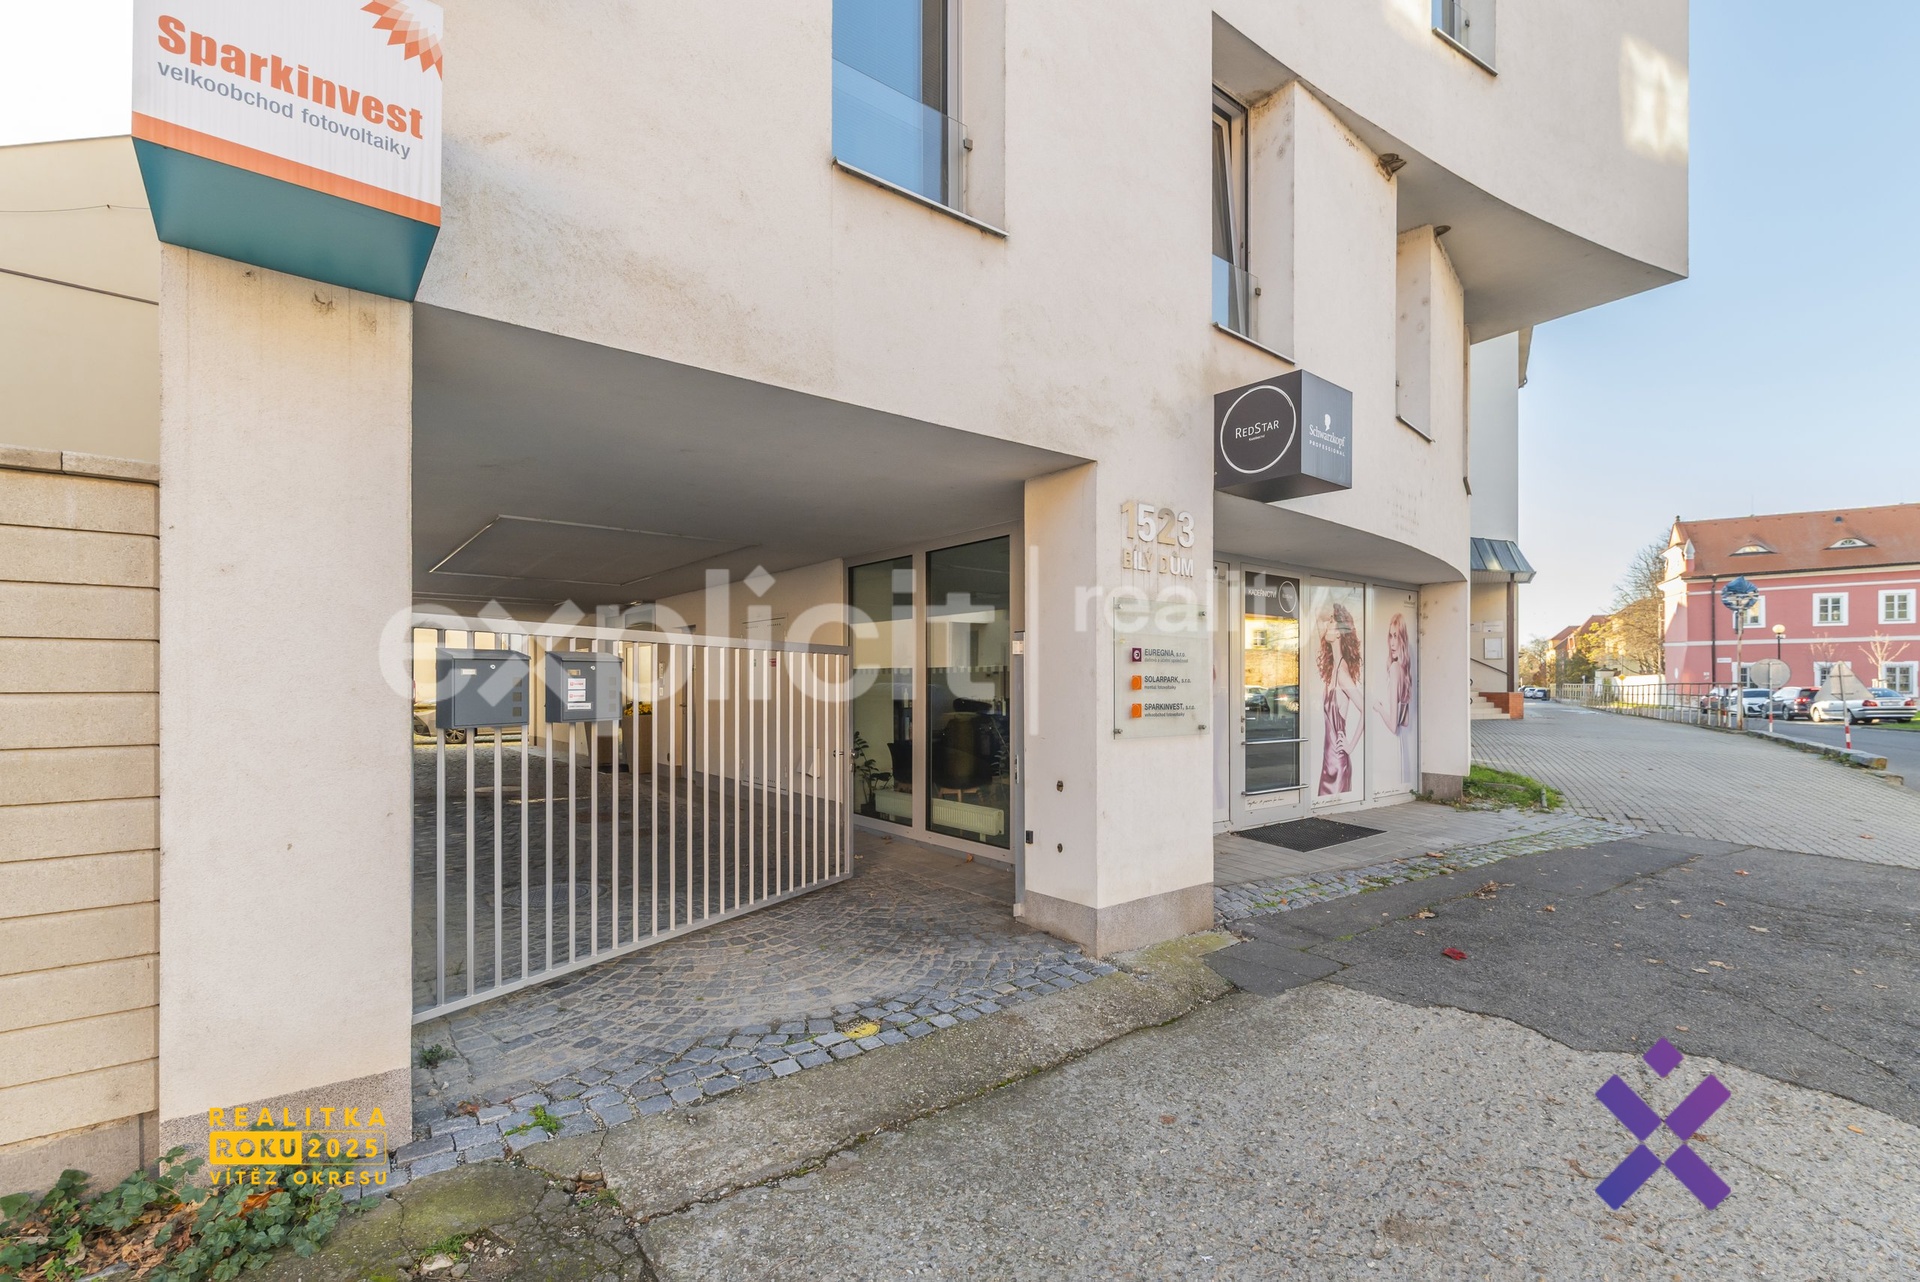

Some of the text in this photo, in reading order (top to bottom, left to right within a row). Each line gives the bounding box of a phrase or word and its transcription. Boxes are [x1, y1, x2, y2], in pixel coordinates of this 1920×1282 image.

[157, 14, 424, 140] Sparkinvest
[157, 61, 411, 161] velkoobchod fotovoltaiky
[1309, 423, 1346, 449] Schwarzkopf
[1309, 439, 1346, 457] PROFESSIONAL
[1120, 500, 1195, 549] 1523
[1158, 550, 1194, 578] DŮM
[1144, 675, 1180, 684] SOLARPARK,
[1144, 703, 1184, 711] SPARKINVEST,
